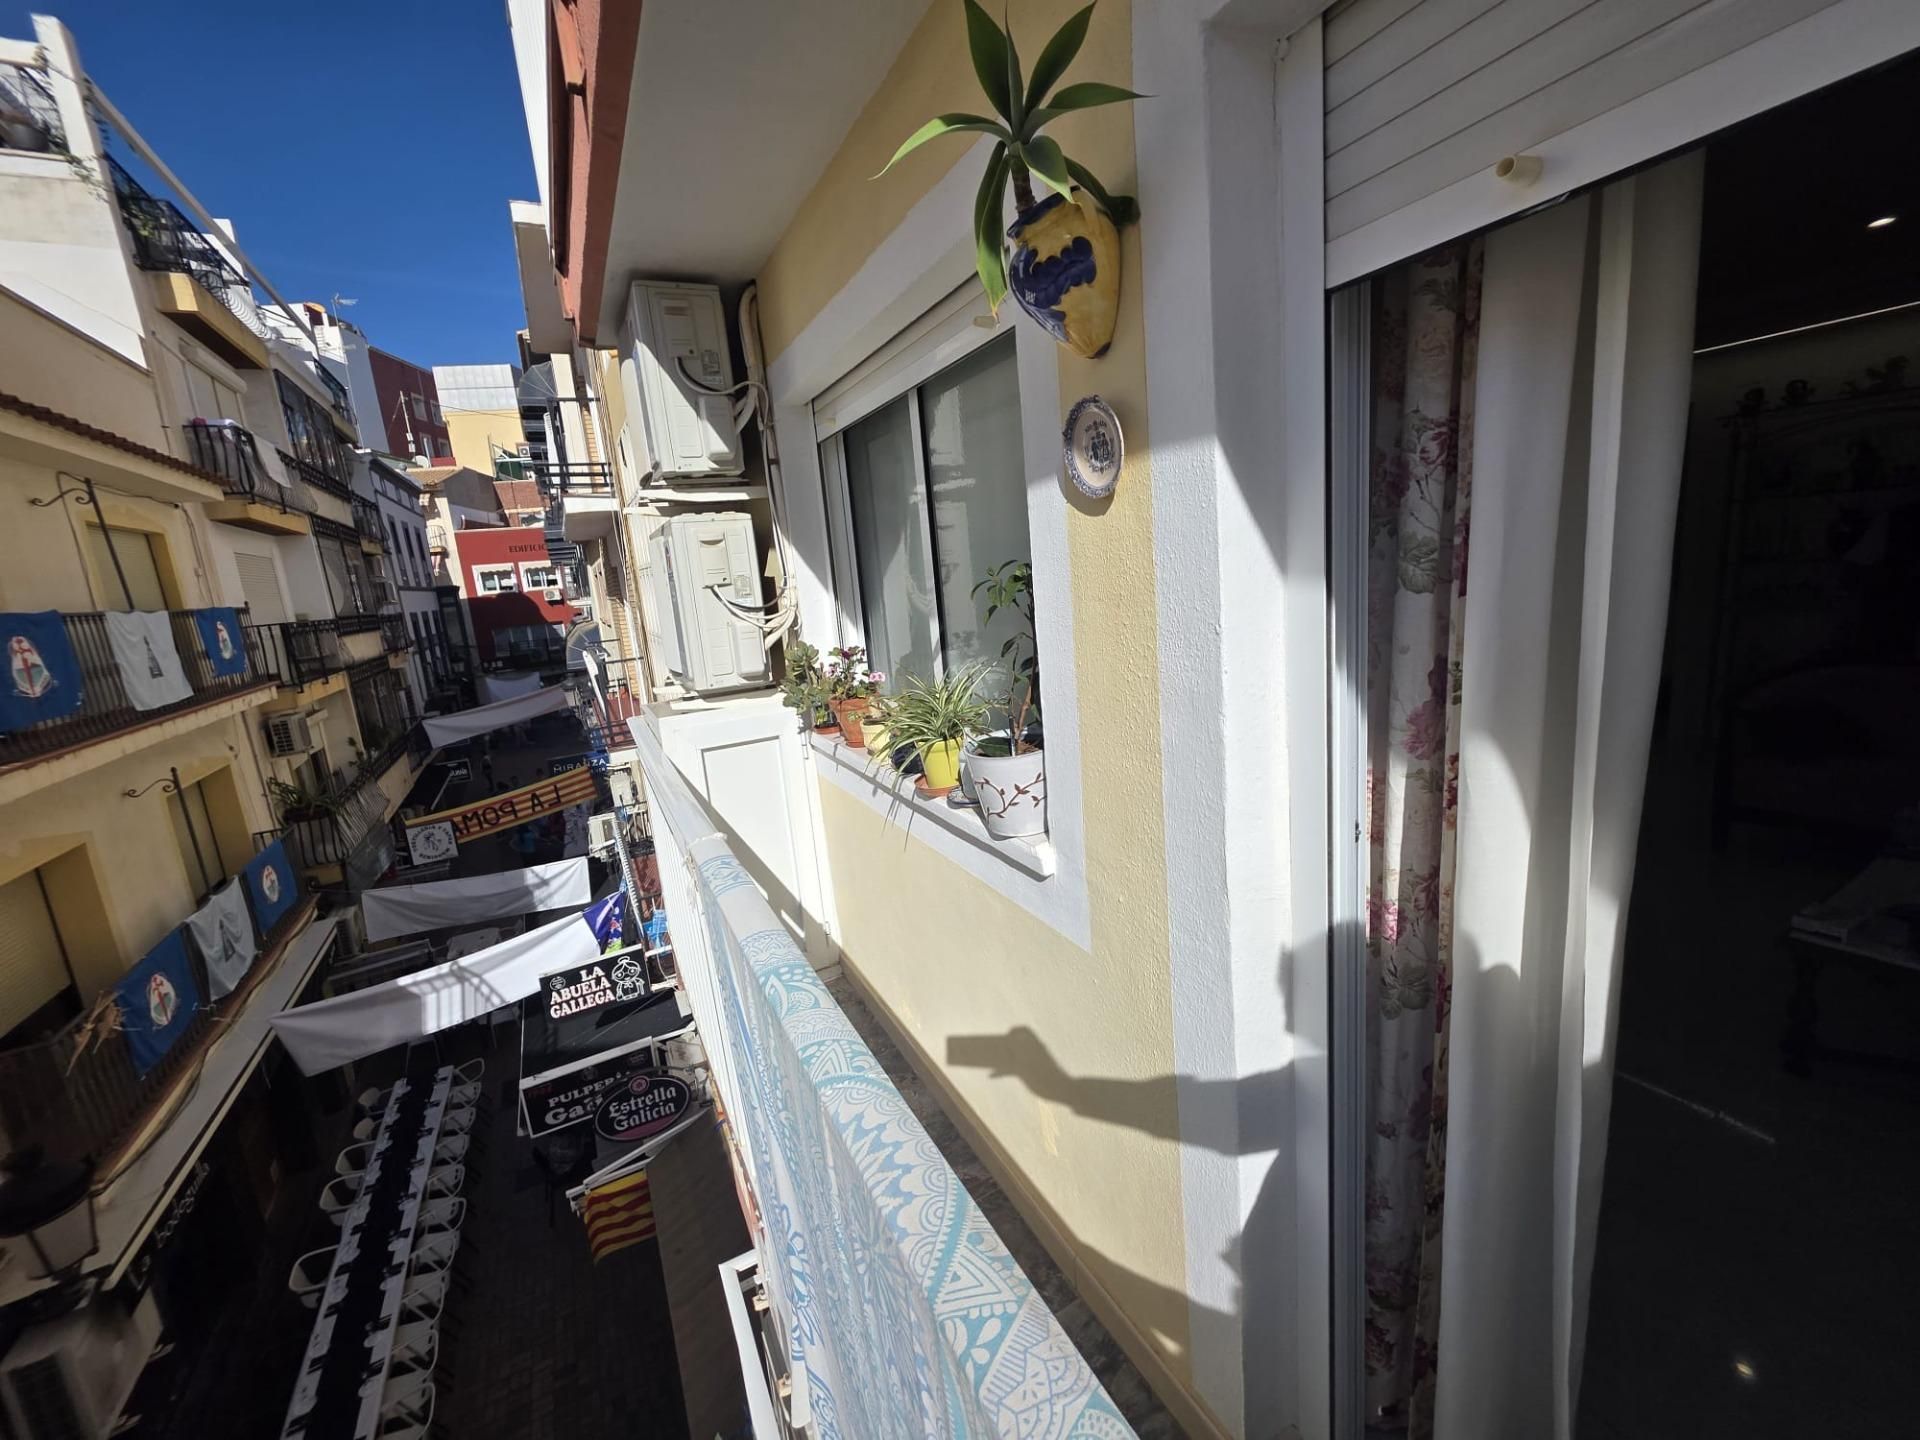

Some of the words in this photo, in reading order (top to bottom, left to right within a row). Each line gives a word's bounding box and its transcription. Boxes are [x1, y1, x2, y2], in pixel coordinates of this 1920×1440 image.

[580, 966, 605, 981] LA
[550, 977, 611, 1005] ABUELA
[550, 989, 615, 1018] GALLEGA
[609, 1086, 677, 1119] Estrella
[613, 1102, 676, 1131] Galicia
